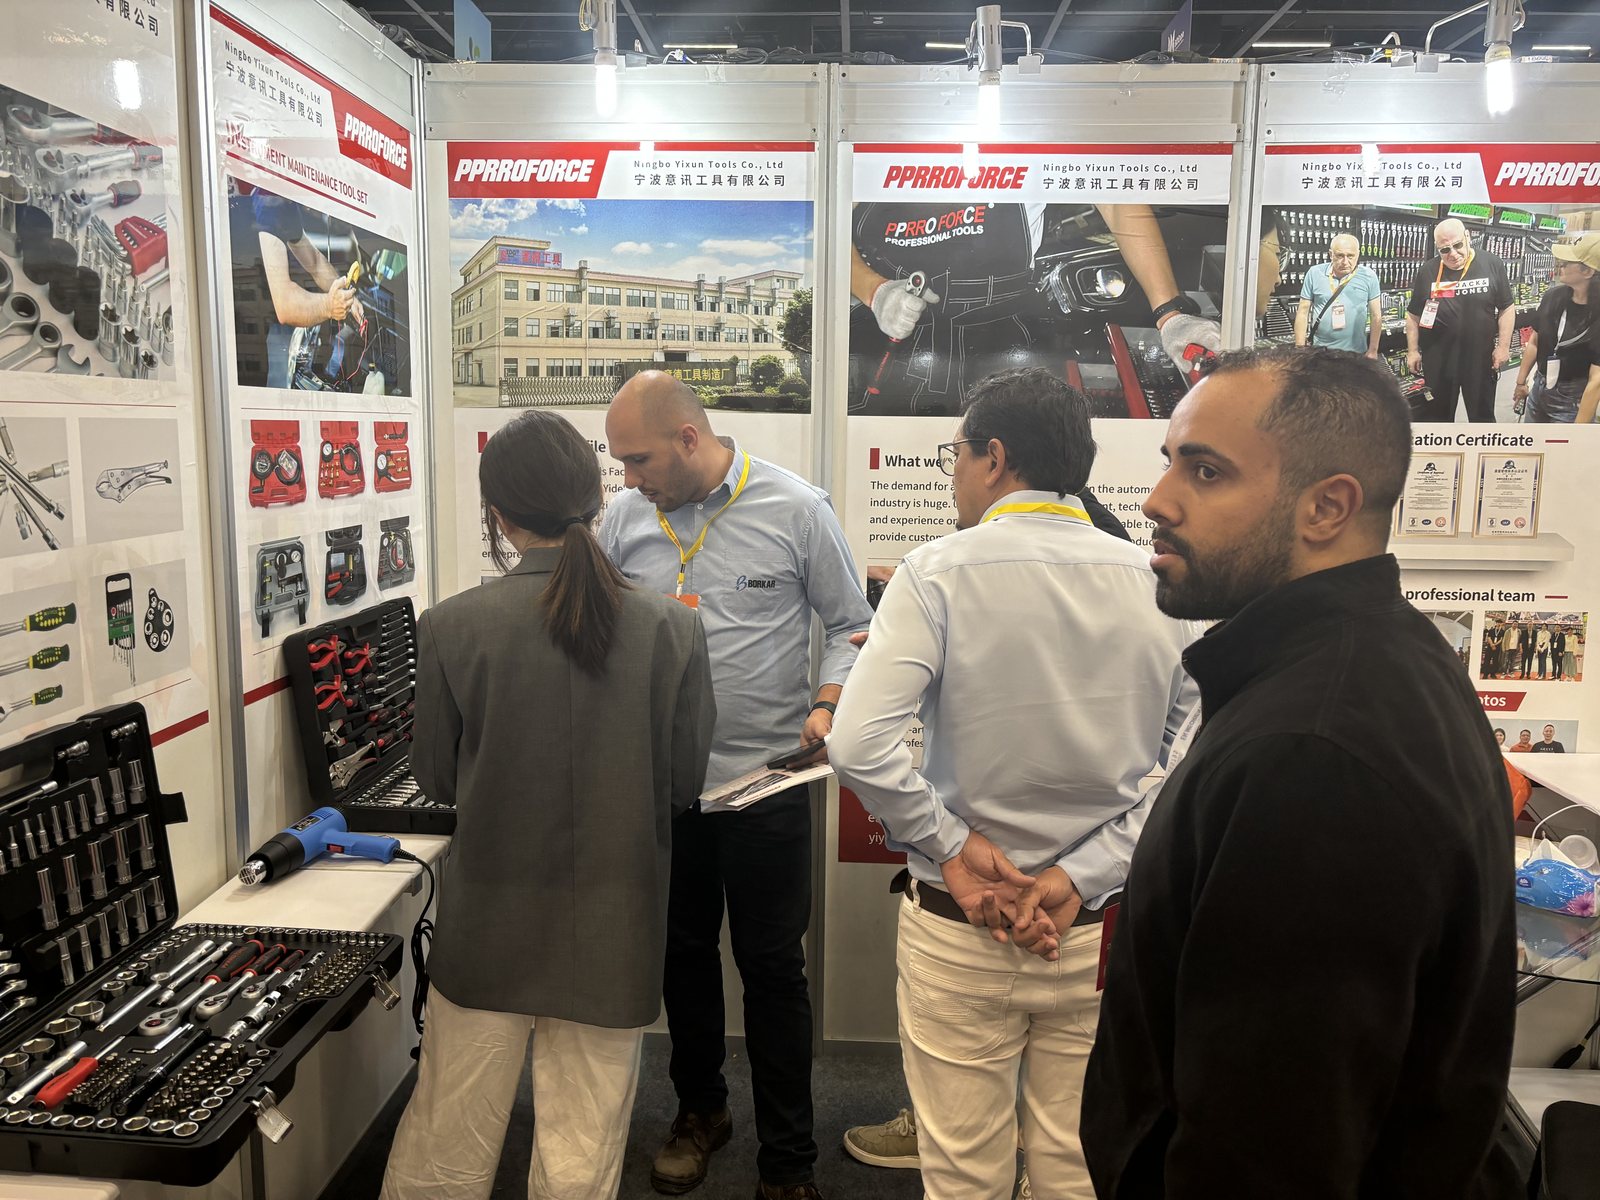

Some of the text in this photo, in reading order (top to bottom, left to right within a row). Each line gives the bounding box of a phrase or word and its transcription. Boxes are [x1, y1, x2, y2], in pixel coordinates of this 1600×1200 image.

[224, 40, 321, 105] Ningbo Yixun Tools Co., Ltd
[226, 60, 323, 128] 宁波意讯工具有限公司
[343, 112, 408, 171] PPRROFORCE
[453, 158, 596, 183] PPRROFORCE
[633, 160, 784, 170] Ningbo Yixun Tools Co., Ltd
[1043, 163, 1198, 174] Ningbo Yixun Tools Co., Ltd
[1302, 162, 1342, 172] Ningbo
[1381, 161, 1412, 170] Tools
[1417, 161, 1440, 171] Co.,
[1444, 161, 1462, 170] Ltd
[287, 156, 338, 192] MAINTENANCE
[338, 180, 357, 201] TOOL
[356, 189, 369, 205] SET
[634, 174, 786, 187] 宁波意讯工具有限公司
[1043, 178, 1199, 191] 宁波意讯工具有限公司
[1301, 176, 1463, 189] 宁波意讯工具有限公司
[885, 205, 986, 237] PPRRO FORCE
[885, 225, 984, 247] PROFESSIONAL TOOLS
[1456, 286, 1488, 296] JONES
[1411, 432, 1533, 447] ation Certificate
[885, 455, 921, 467] What
[871, 481, 889, 490] The
[891, 481, 932, 491] demand
[934, 482, 948, 491] for
[1098, 484, 1115, 494] the
[870, 498, 911, 509] industry
[913, 499, 921, 507] is
[923, 499, 951, 510] huge.
[1118, 502, 1142, 511] tech
[869, 516, 888, 524] and
[890, 516, 944, 526] experience
[1145, 520, 1155, 529] to
[869, 532, 906, 542] provide
[748, 579, 776, 589] BORKAR
[1405, 588, 1535, 602] professional team
